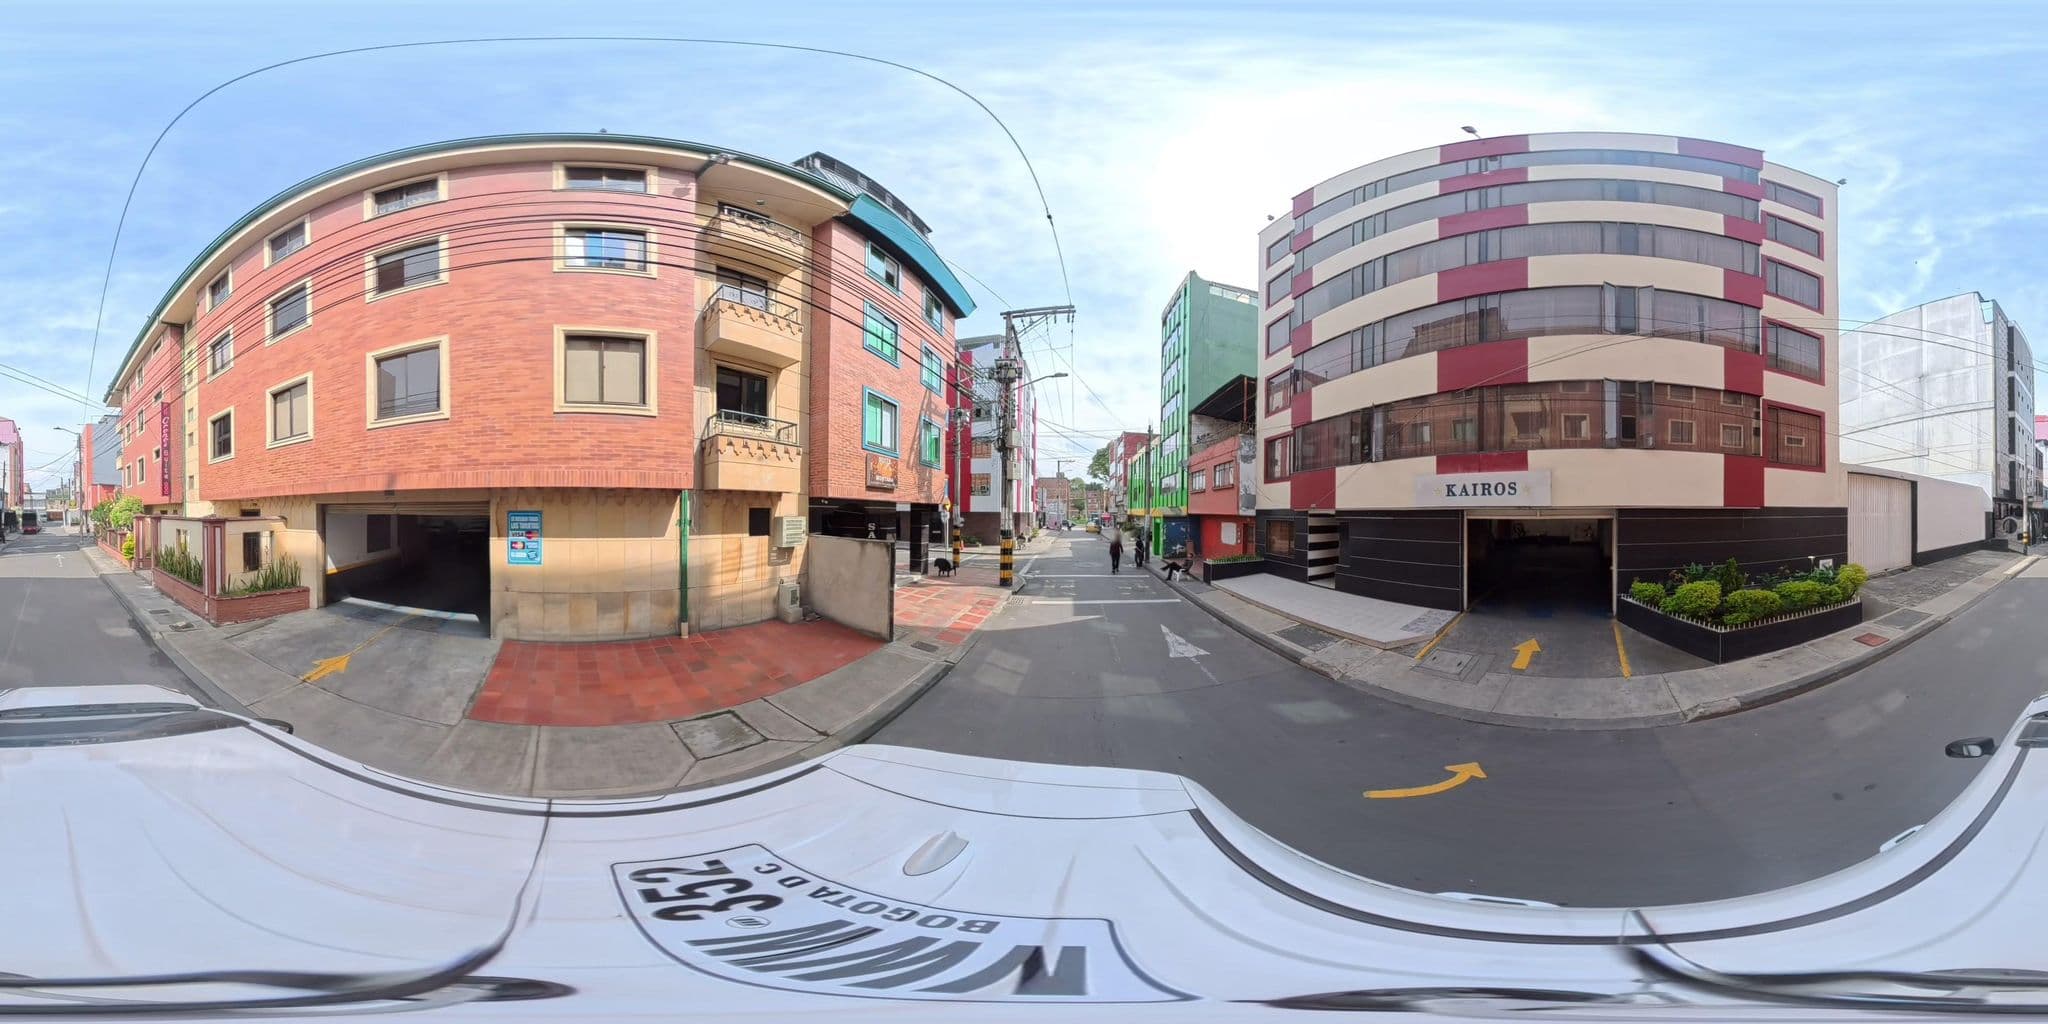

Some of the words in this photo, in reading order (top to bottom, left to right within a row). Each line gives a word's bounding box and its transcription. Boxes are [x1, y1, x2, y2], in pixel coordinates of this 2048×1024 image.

[1445, 482, 1517, 497] KAIROS
[754, 863, 782, 874] C
[777, 875, 810, 888] D
[628, 859, 785, 921] 352
[807, 885, 1000, 934] BOGOTA
[684, 919, 1087, 996] NWW
